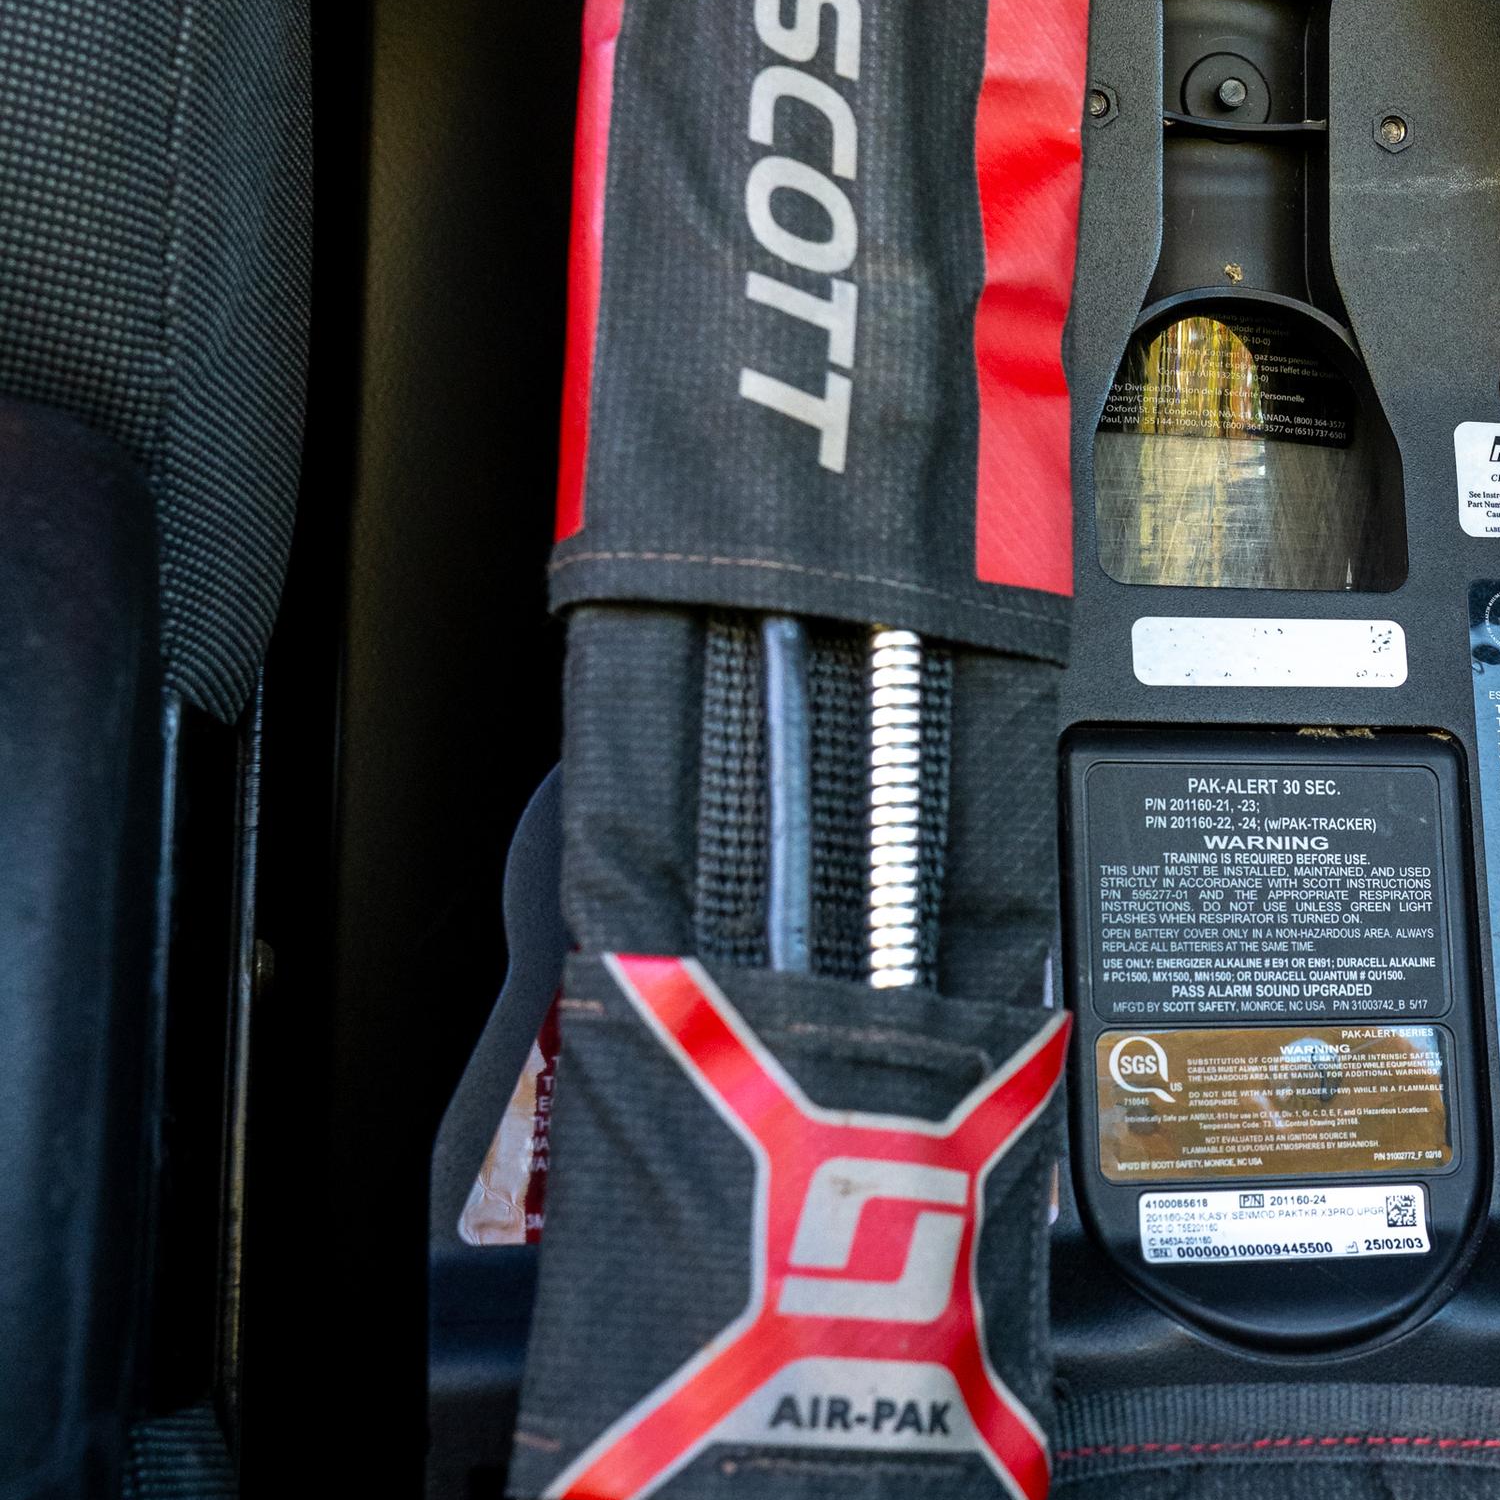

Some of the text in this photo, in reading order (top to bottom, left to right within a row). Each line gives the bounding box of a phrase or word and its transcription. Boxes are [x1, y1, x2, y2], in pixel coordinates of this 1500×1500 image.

[1260, 391, 1305, 403] Personnelle
[1124, 416, 1140, 424] MN
[1295, 426, 1313, 436] (651)
[1468, 490, 1481, 498] See
[1188, 778, 1340, 795] PAK-ALERT 30 SEC.
[1145, 798, 1259, 813] P/N 201160-21, -23;
[1145, 815, 1376, 831] P/N 201160-22, -24; (w/PAK-TRACKER)
[1203, 835, 1328, 850] WARNING
[1162, 852, 1370, 865] TRAINING IS REQUIRED BEFORE USE.
[1100, 865, 1430, 877] THIS UNIT MUST BE INSTALLED, MAINTAINED, AND USED
[1100, 877, 1431, 888] STRICTLY IN ACCORDANCE WITH SCOTT INSTRUCTIONS
[1100, 889, 1432, 900] P/N 595277-01 AND THE APPROPRIATE RESPIRATOR
[1101, 901, 1432, 912] INSTRUCTIONS. DO NOT USE UNLESS GREEN LIGHT
[1101, 913, 1362, 923] FLASHES WHEN RESPIRATOR IS TURNED ON.
[1172, 983, 1372, 997] PASS ALARM SOUND UPGRADED
[1112, 999, 1427, 1012] MFG'D BY SCOTT SAFETY, MONROE, NC USA P/N 31003742_B 5/17
[1341, 1027, 1433, 1038] PAK-ALERT SERIES
[1279, 1044, 1350, 1055] WARNING
[1120, 1055, 1157, 1074] SGS
[1170, 1082, 1183, 1092] US
[1242, 1195, 1261, 1206] P/N
[1270, 1195, 1326, 1205] 201160-24
[1176, 1242, 1332, 1257] 000000100009445500
[1364, 1237, 1423, 1250] 25/02/03
[769, 1394, 954, 1437] AIR-PAK
